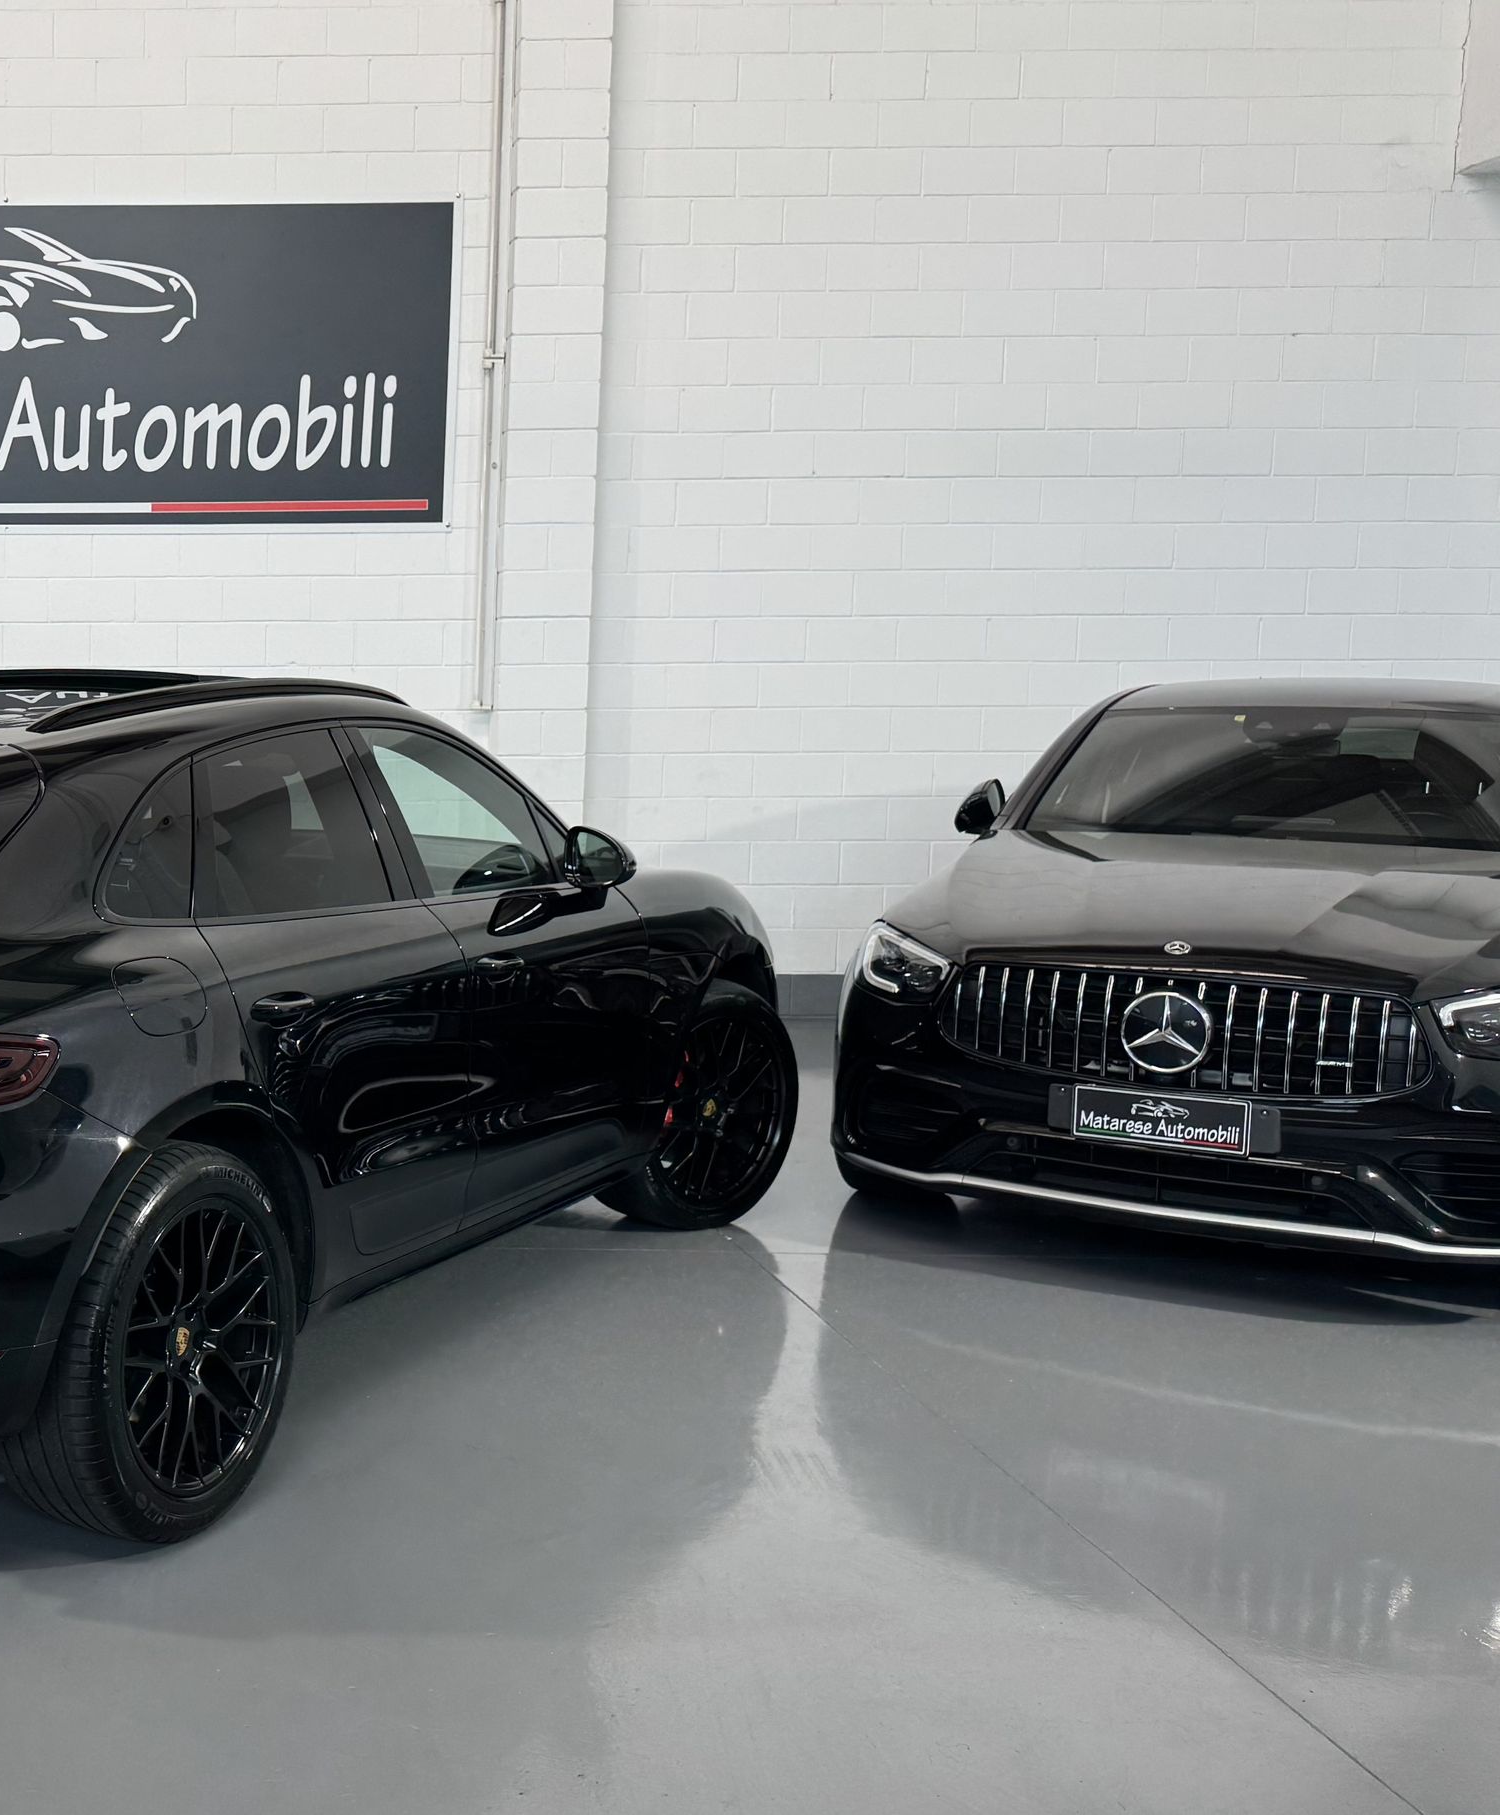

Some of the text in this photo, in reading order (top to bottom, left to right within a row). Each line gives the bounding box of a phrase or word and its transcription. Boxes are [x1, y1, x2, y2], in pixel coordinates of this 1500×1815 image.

[1080, 1110, 1240, 1144] Matarese Automobili
[213, 1165, 263, 1201] MICHELIN
